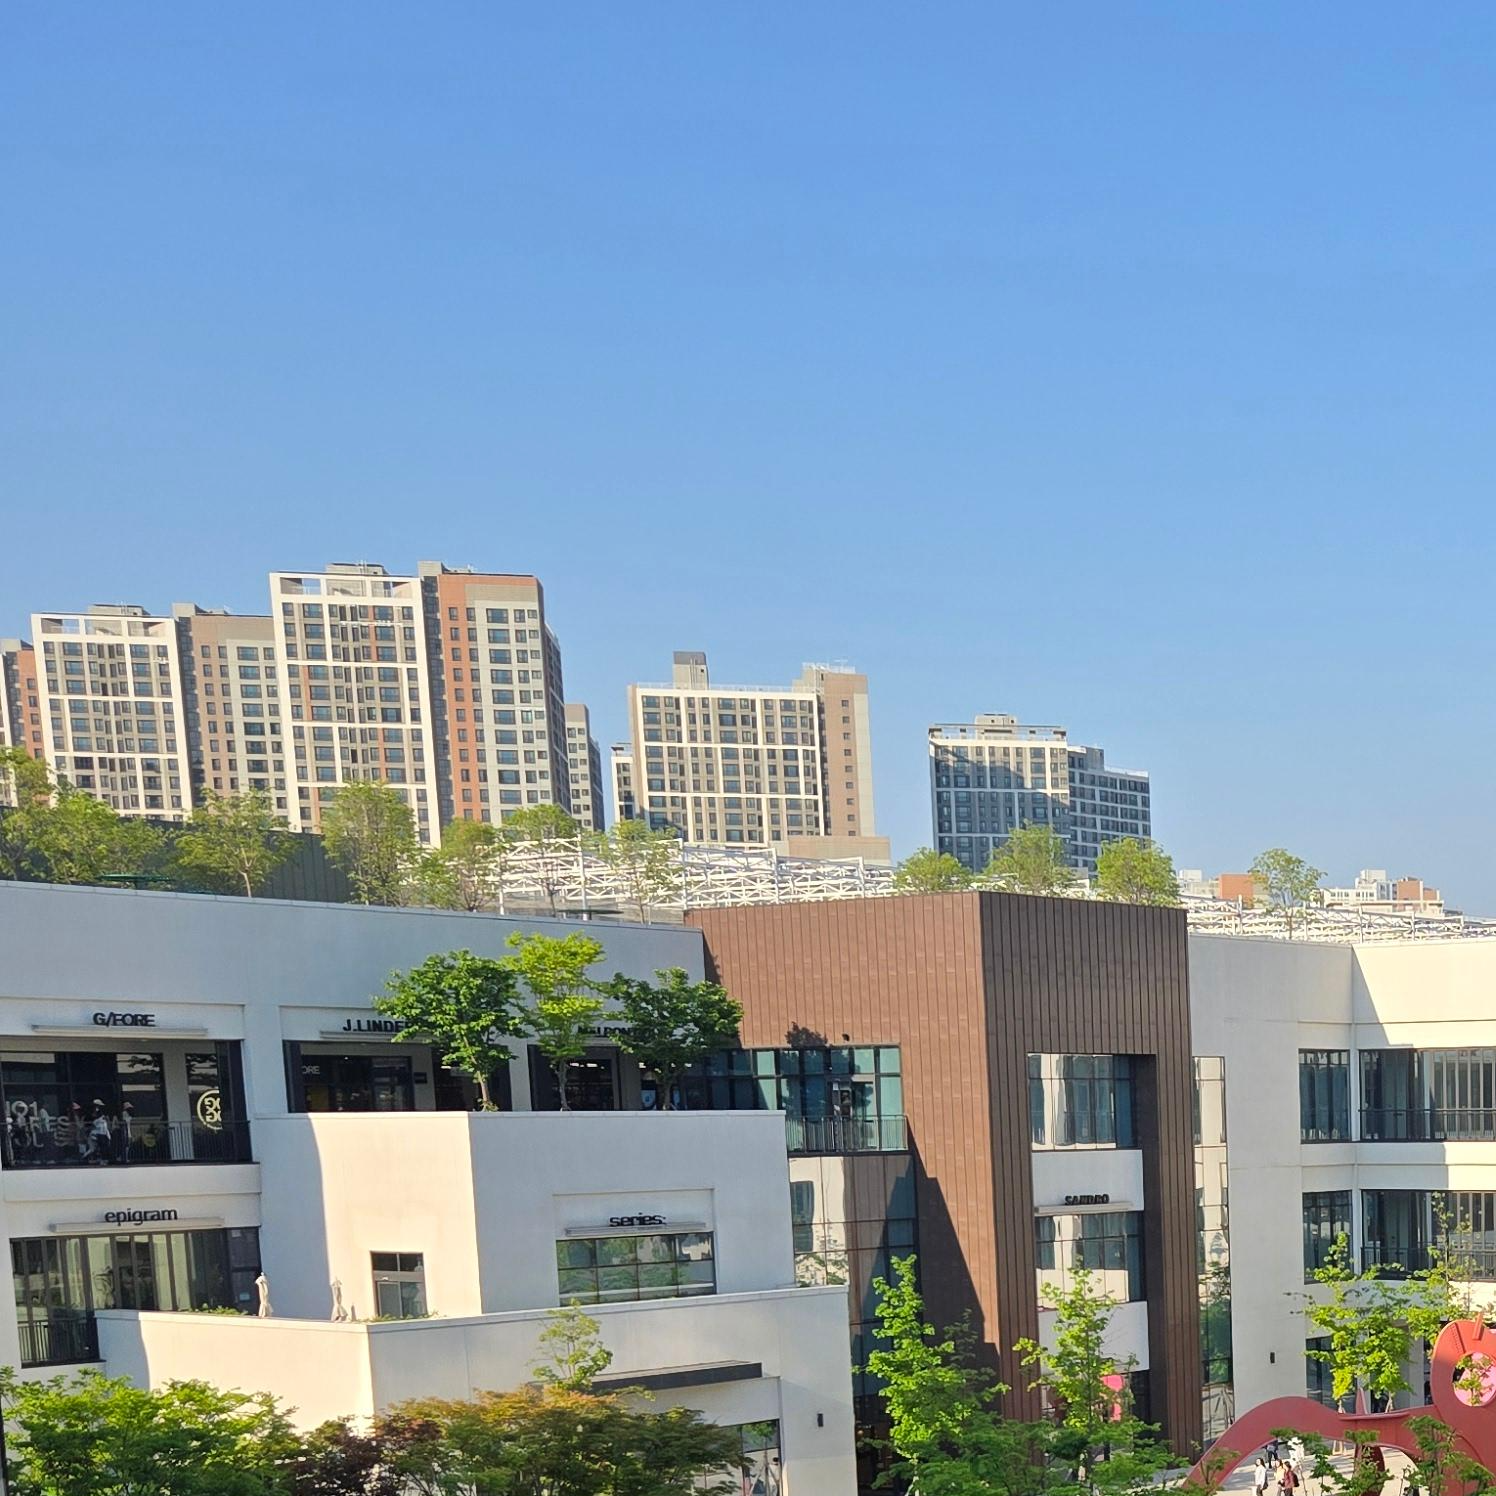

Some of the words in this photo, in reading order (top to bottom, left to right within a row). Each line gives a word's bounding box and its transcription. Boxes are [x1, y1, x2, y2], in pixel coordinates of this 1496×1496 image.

[92, 1011, 156, 1028] G/FORE
[1064, 1193, 1110, 1206] SANDRO
[104, 1207, 178, 1227] epigram
